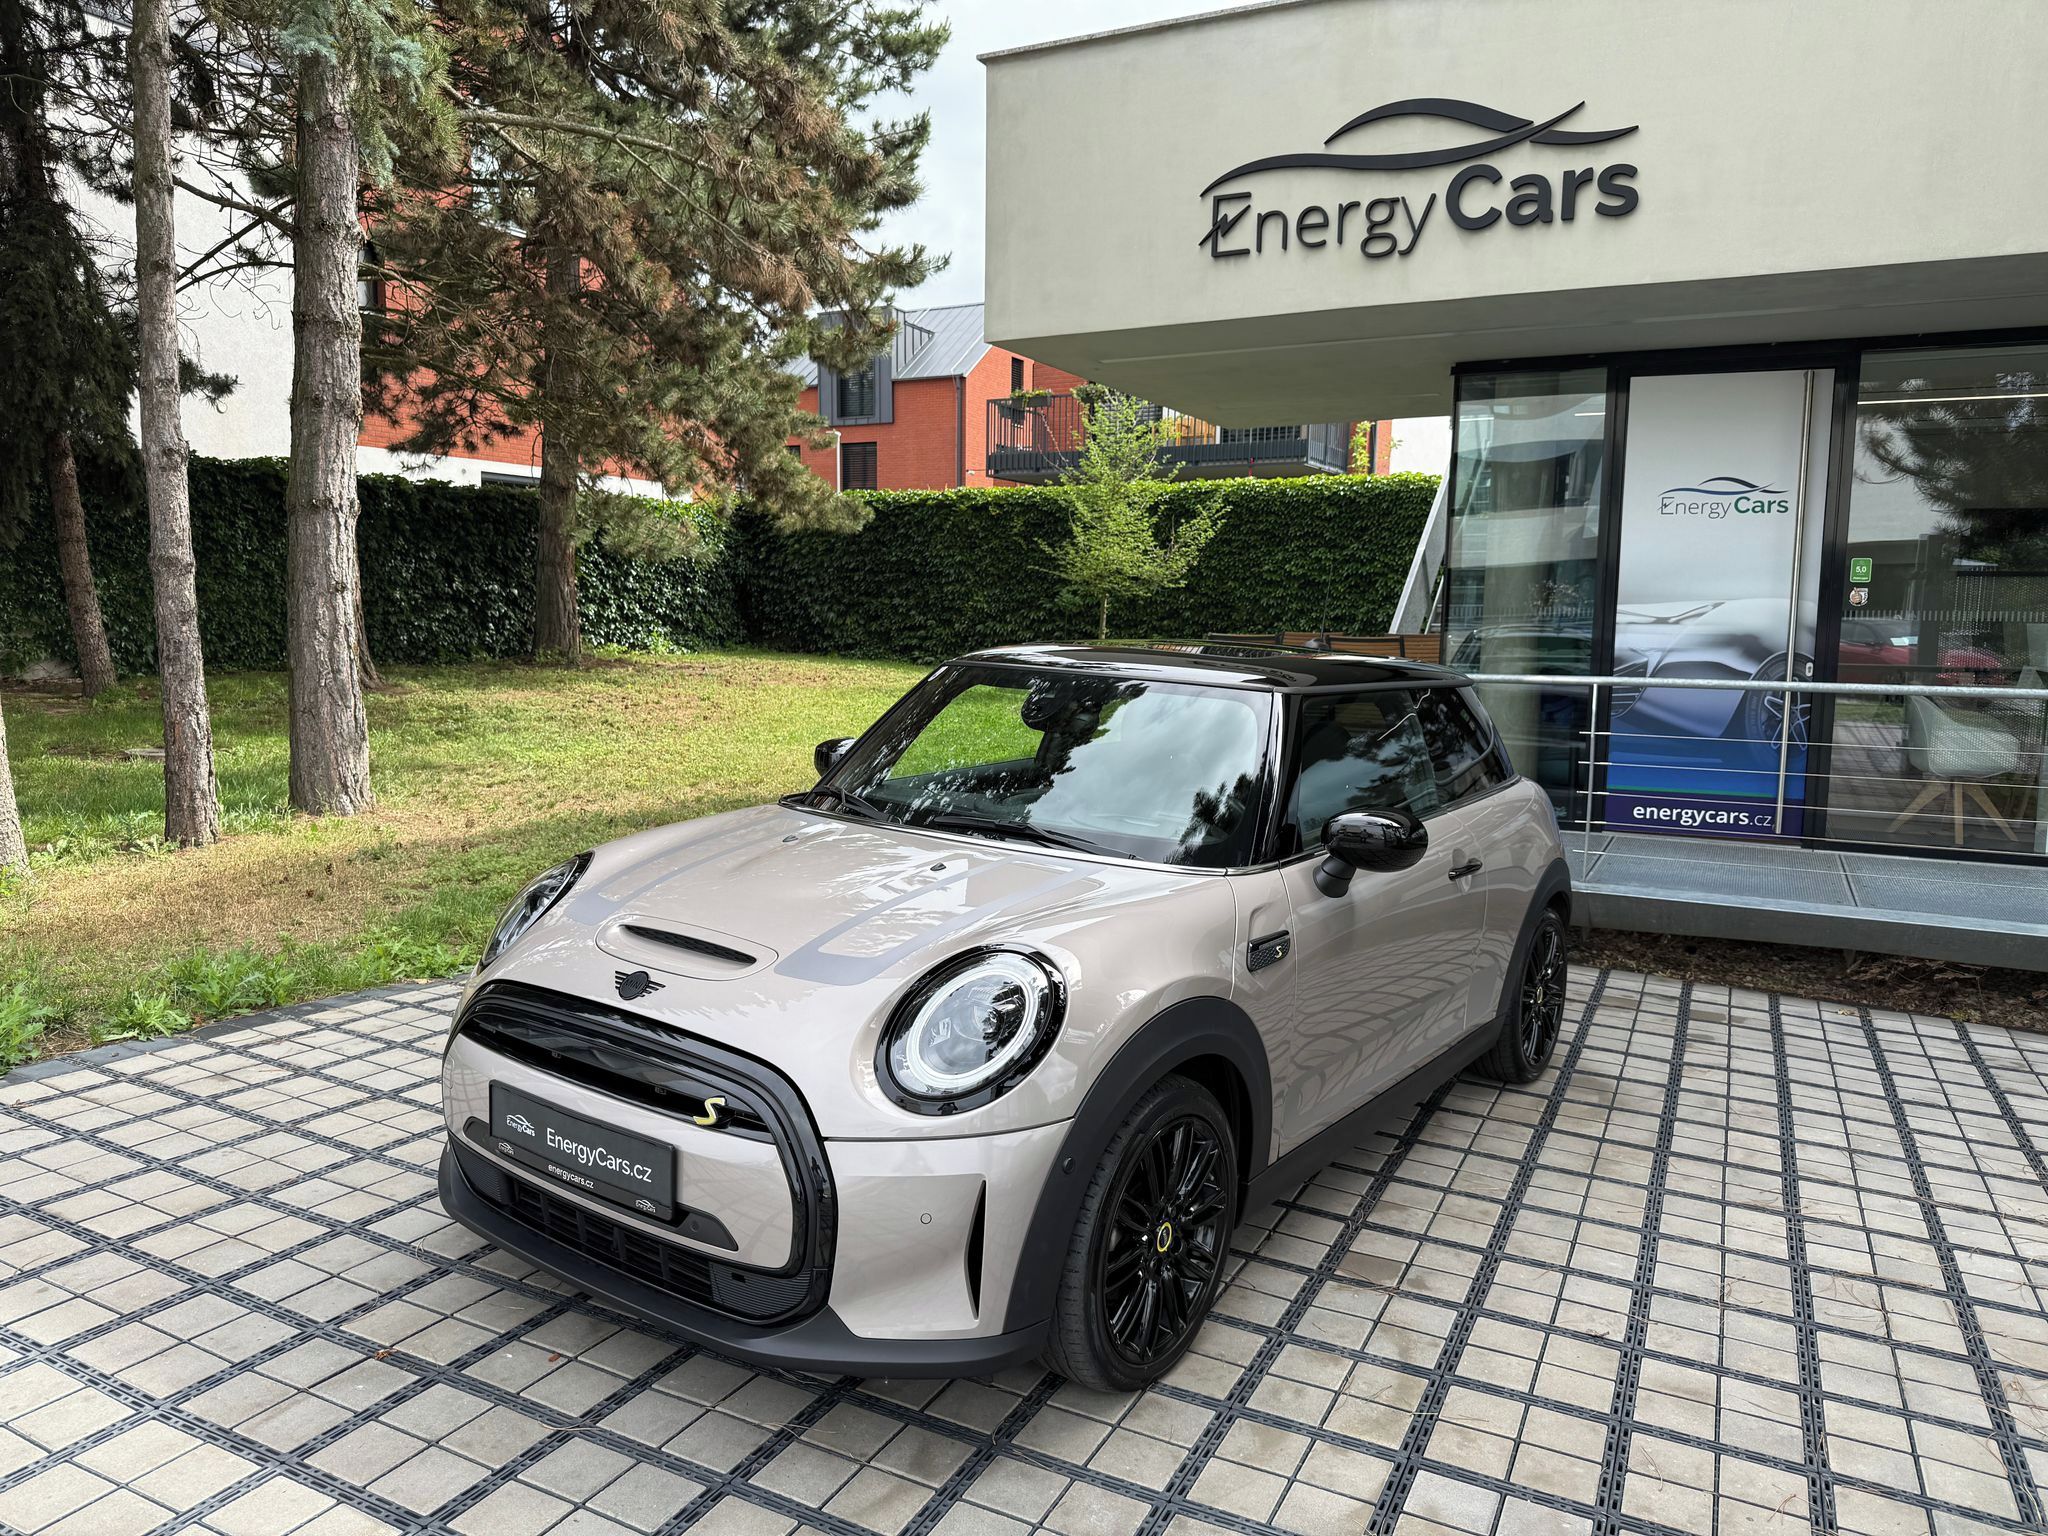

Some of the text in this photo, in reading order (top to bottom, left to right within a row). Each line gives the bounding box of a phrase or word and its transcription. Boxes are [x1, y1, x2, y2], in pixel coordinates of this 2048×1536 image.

[1199, 163, 1639, 258] EnergyCars
[1658, 496, 1789, 519] EnergyCars
[1633, 805, 1772, 826] energycars.cz
[1275, 945, 1283, 959] S
[693, 1097, 726, 1126] S
[546, 1127, 652, 1183] EnergyCars.cz
[547, 1164, 594, 1189] energycars.cz
